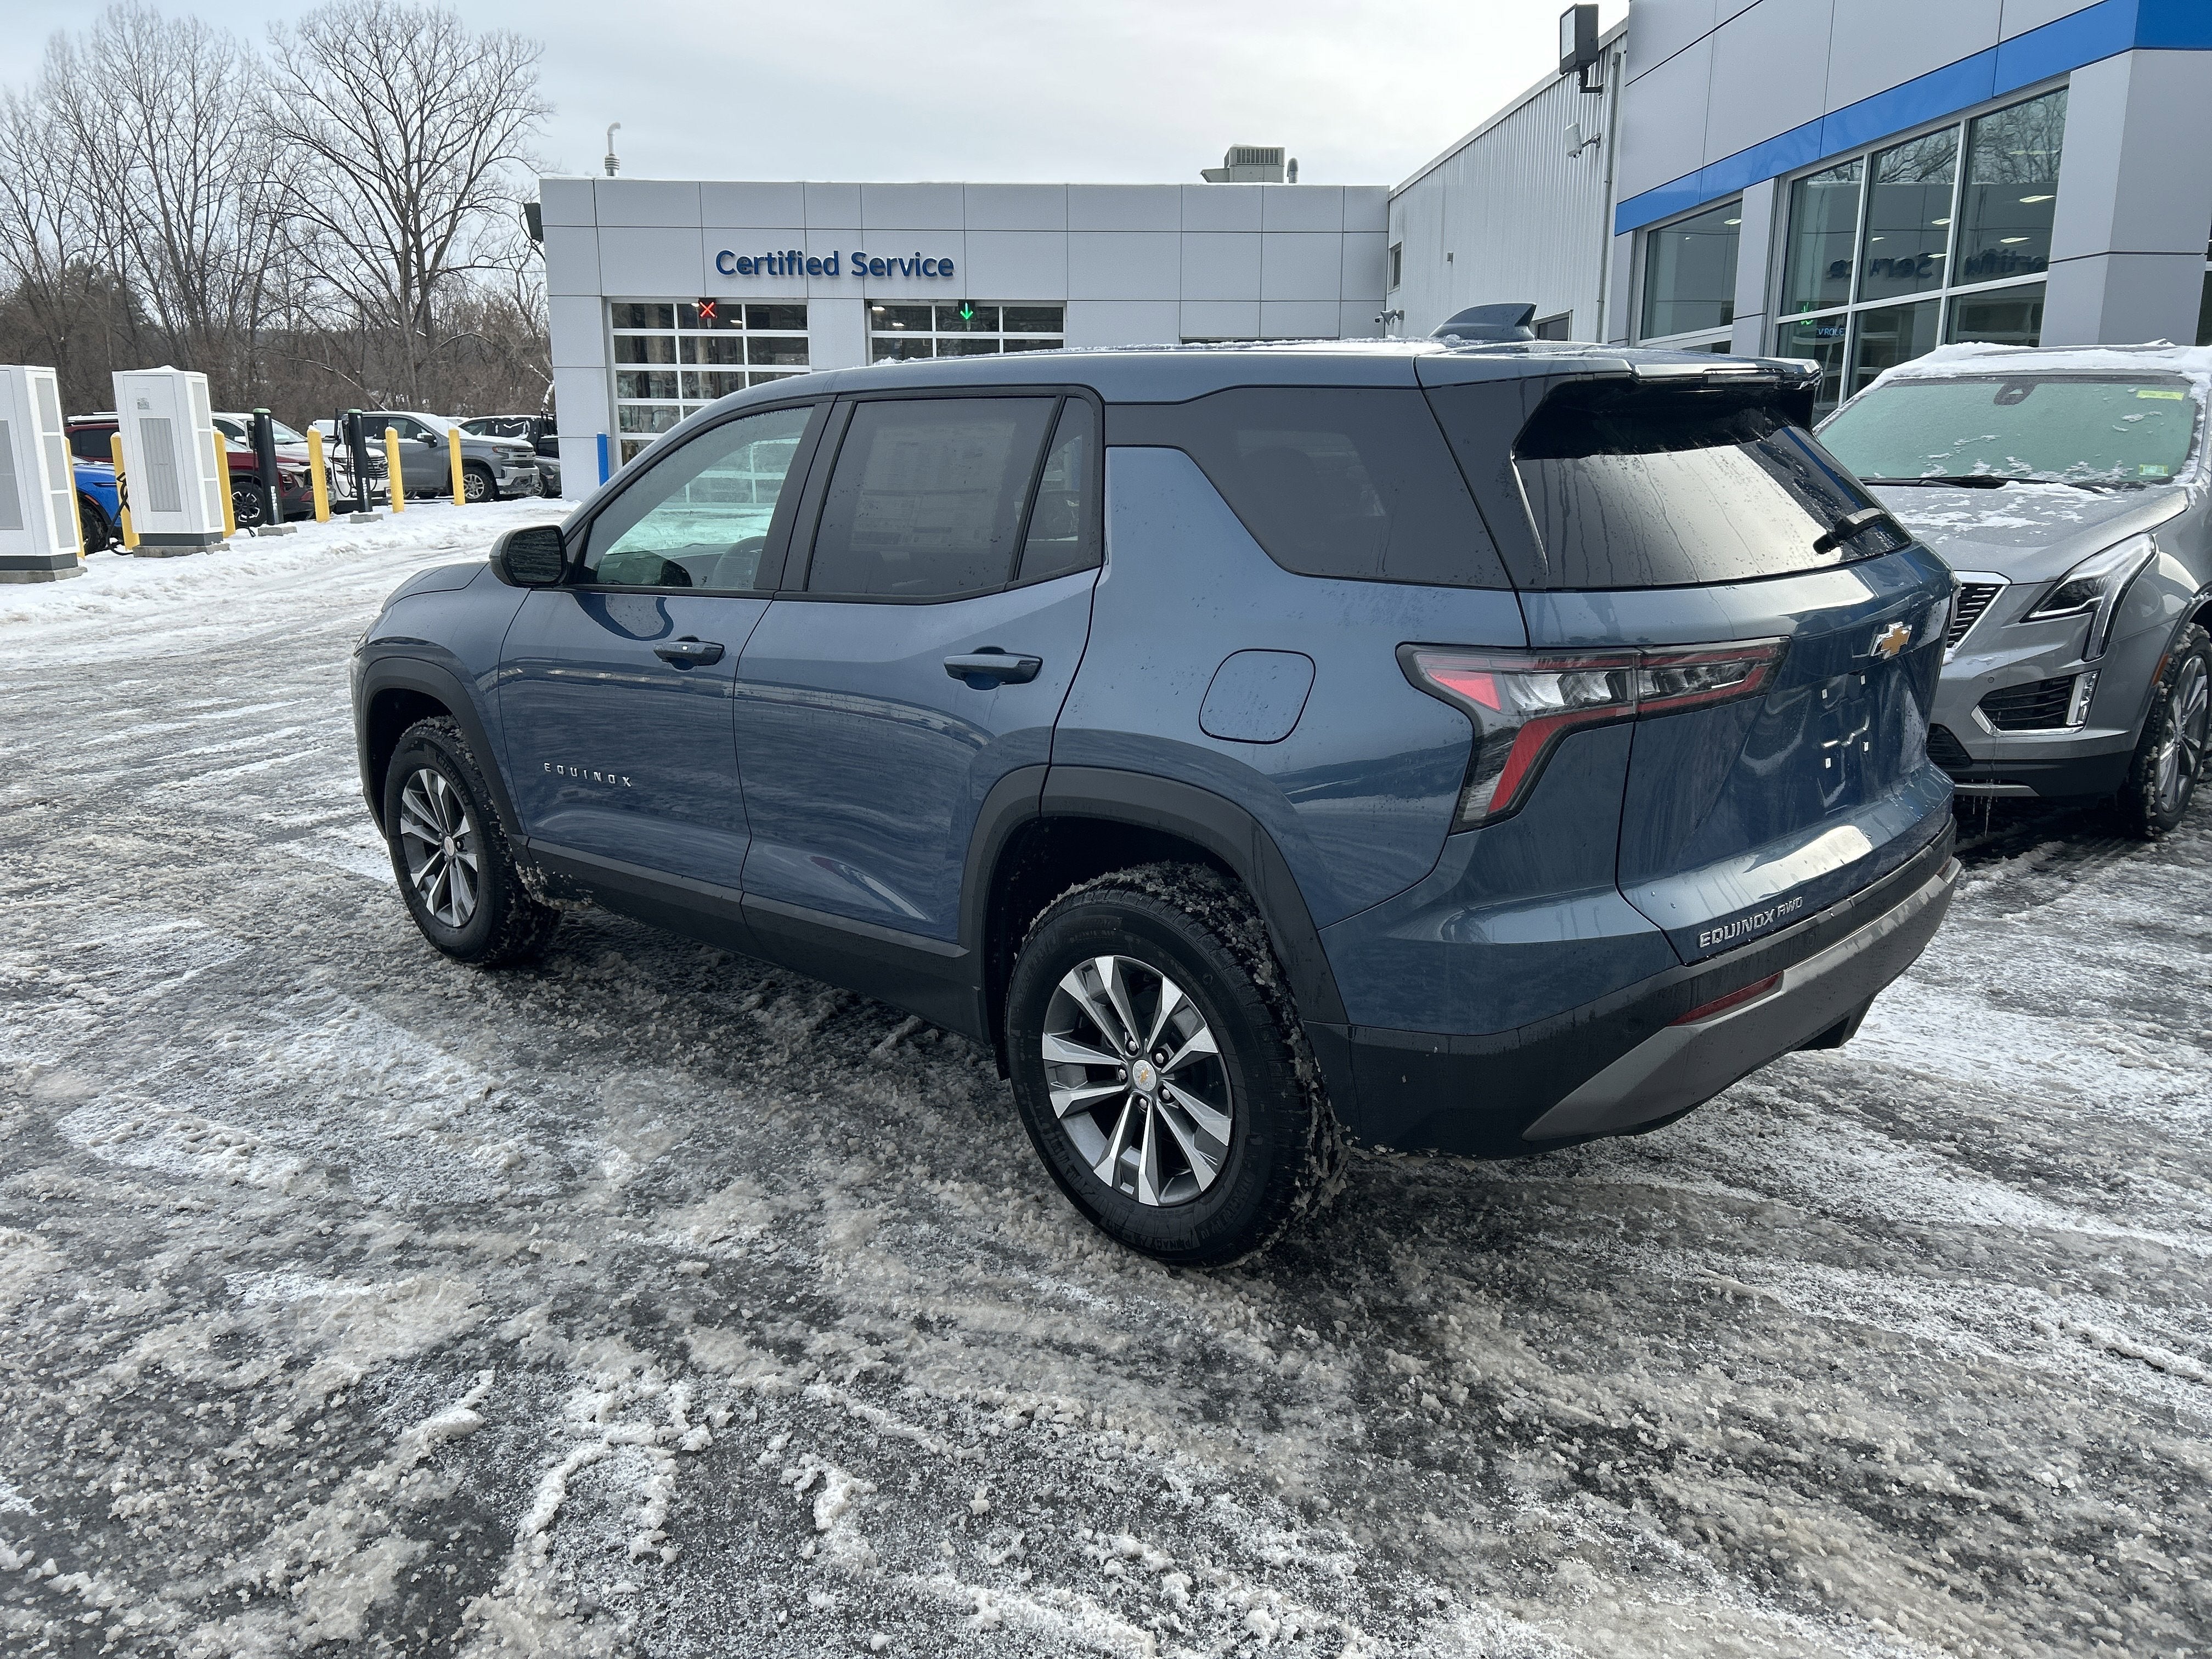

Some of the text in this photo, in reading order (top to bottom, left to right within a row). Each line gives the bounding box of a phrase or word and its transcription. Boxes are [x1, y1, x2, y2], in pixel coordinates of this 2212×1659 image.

[715, 250, 954, 276] Certified Service
[1816, 328, 1846, 336] VROLE
[544, 763, 631, 787] EQUINOX
[1700, 896, 1803, 948] EQUINOX AWD
